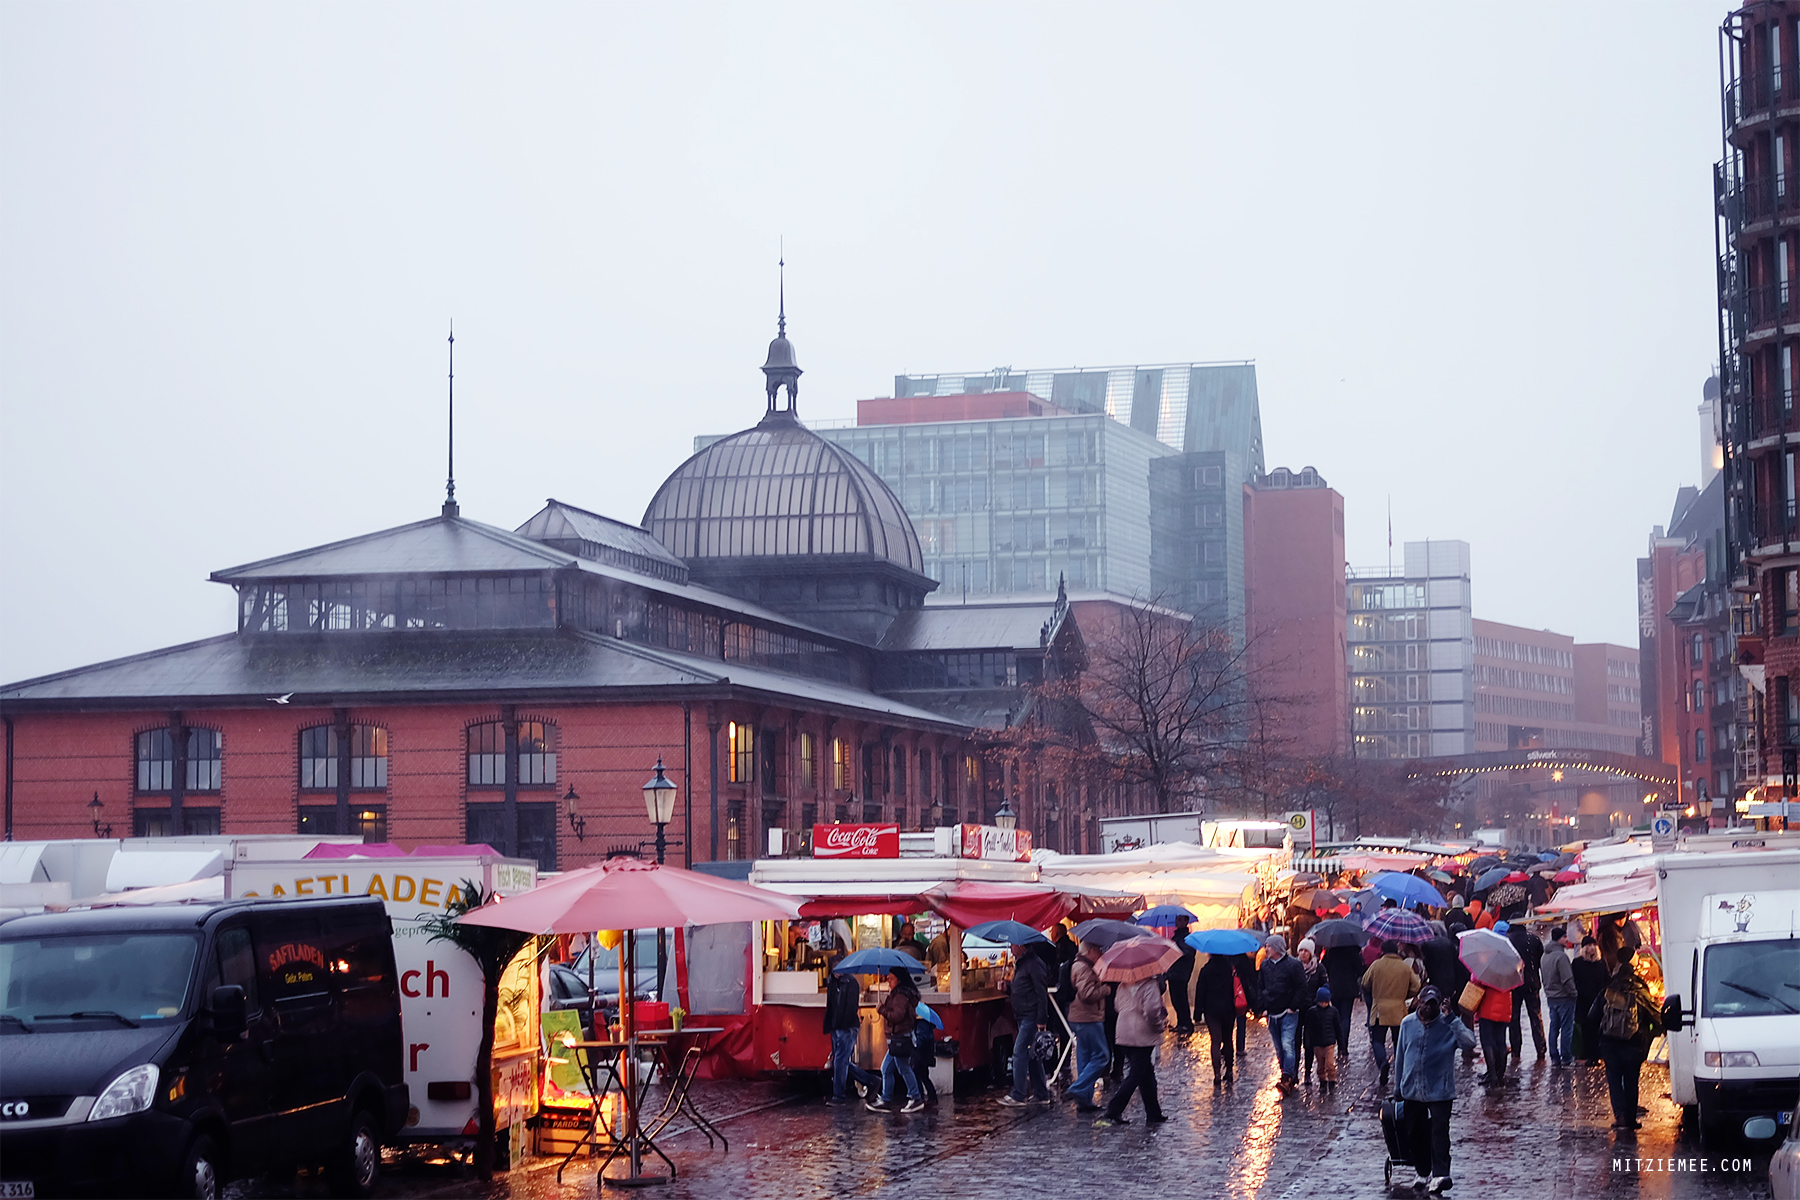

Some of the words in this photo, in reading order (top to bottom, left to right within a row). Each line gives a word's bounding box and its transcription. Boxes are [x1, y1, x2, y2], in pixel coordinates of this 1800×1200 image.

[1639, 577, 1656, 638] stilwerk
[1642, 715, 1653, 756] stilwerk
[1527, 749, 1557, 760] stilwerk
[827, 827, 879, 847] Coca-Cola
[244, 874, 467, 910] FTLADEN
[269, 944, 324, 972] SAFTLADEN
[0, 1102, 29, 1116] CO
[9, 1183, 32, 1197] 316
